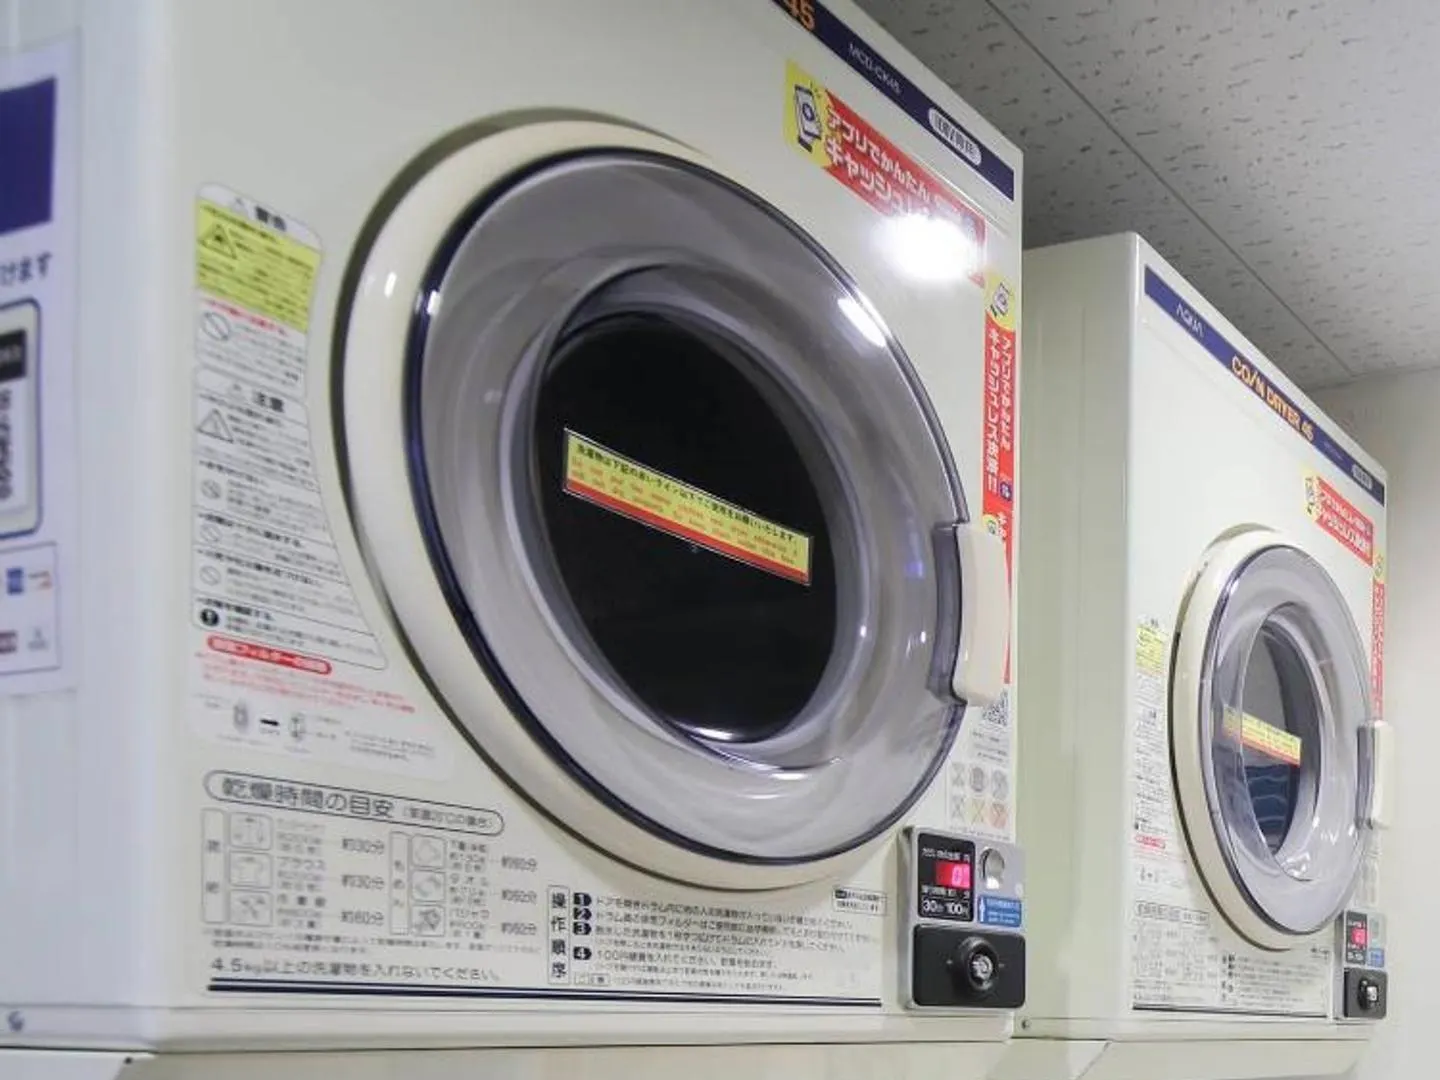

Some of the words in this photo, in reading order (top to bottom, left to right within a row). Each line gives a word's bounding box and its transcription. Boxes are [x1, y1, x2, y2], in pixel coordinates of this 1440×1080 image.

[222, 778, 394, 819] 乾燥時間の目安
